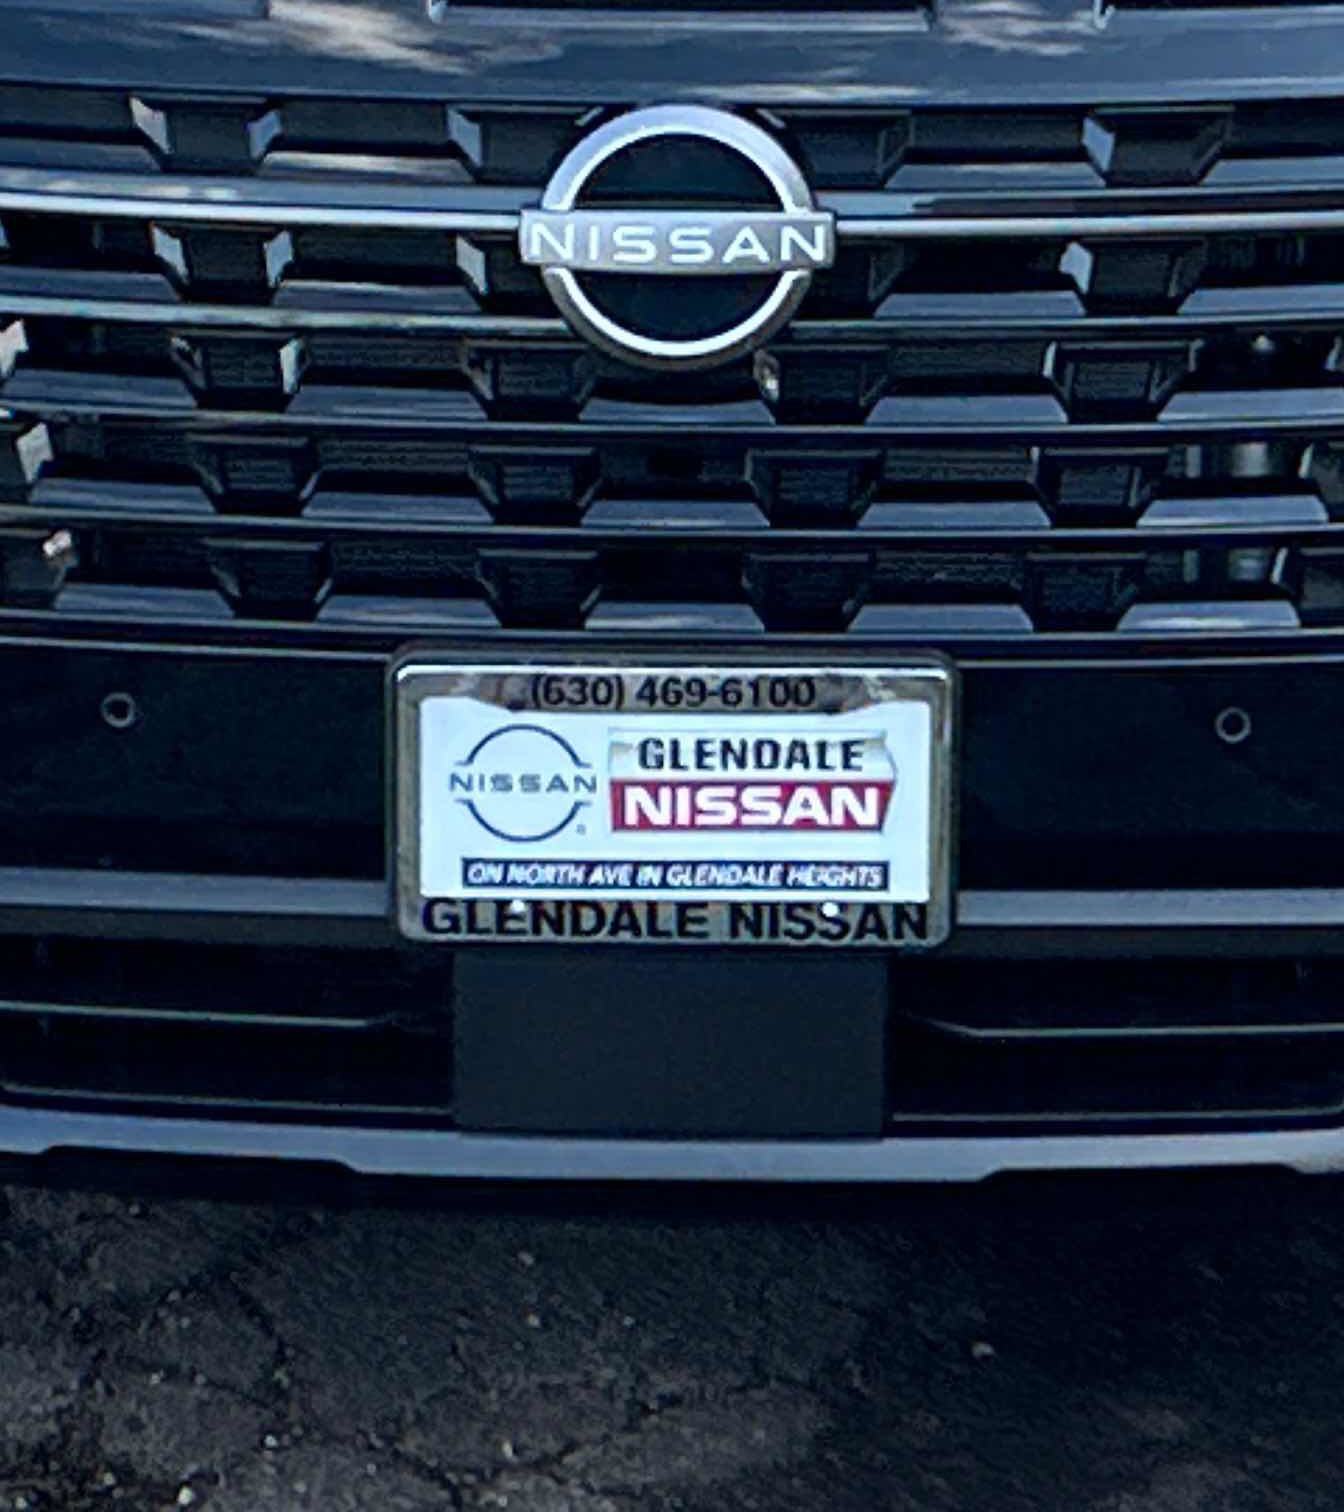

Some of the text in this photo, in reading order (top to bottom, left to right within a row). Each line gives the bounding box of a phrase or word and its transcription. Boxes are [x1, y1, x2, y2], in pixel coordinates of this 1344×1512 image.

[530, 223, 826, 264] NISSAN
[531, 675, 816, 709] (630) 469-6100
[638, 738, 864, 772] GLENDALE
[449, 772, 598, 794] NISSAN
[623, 785, 878, 827] NISSAN
[467, 863, 883, 888] ON NORTH AVE IN GLENDALE HEIGHTS
[421, 897, 928, 941] GLENDALE NISSAN
